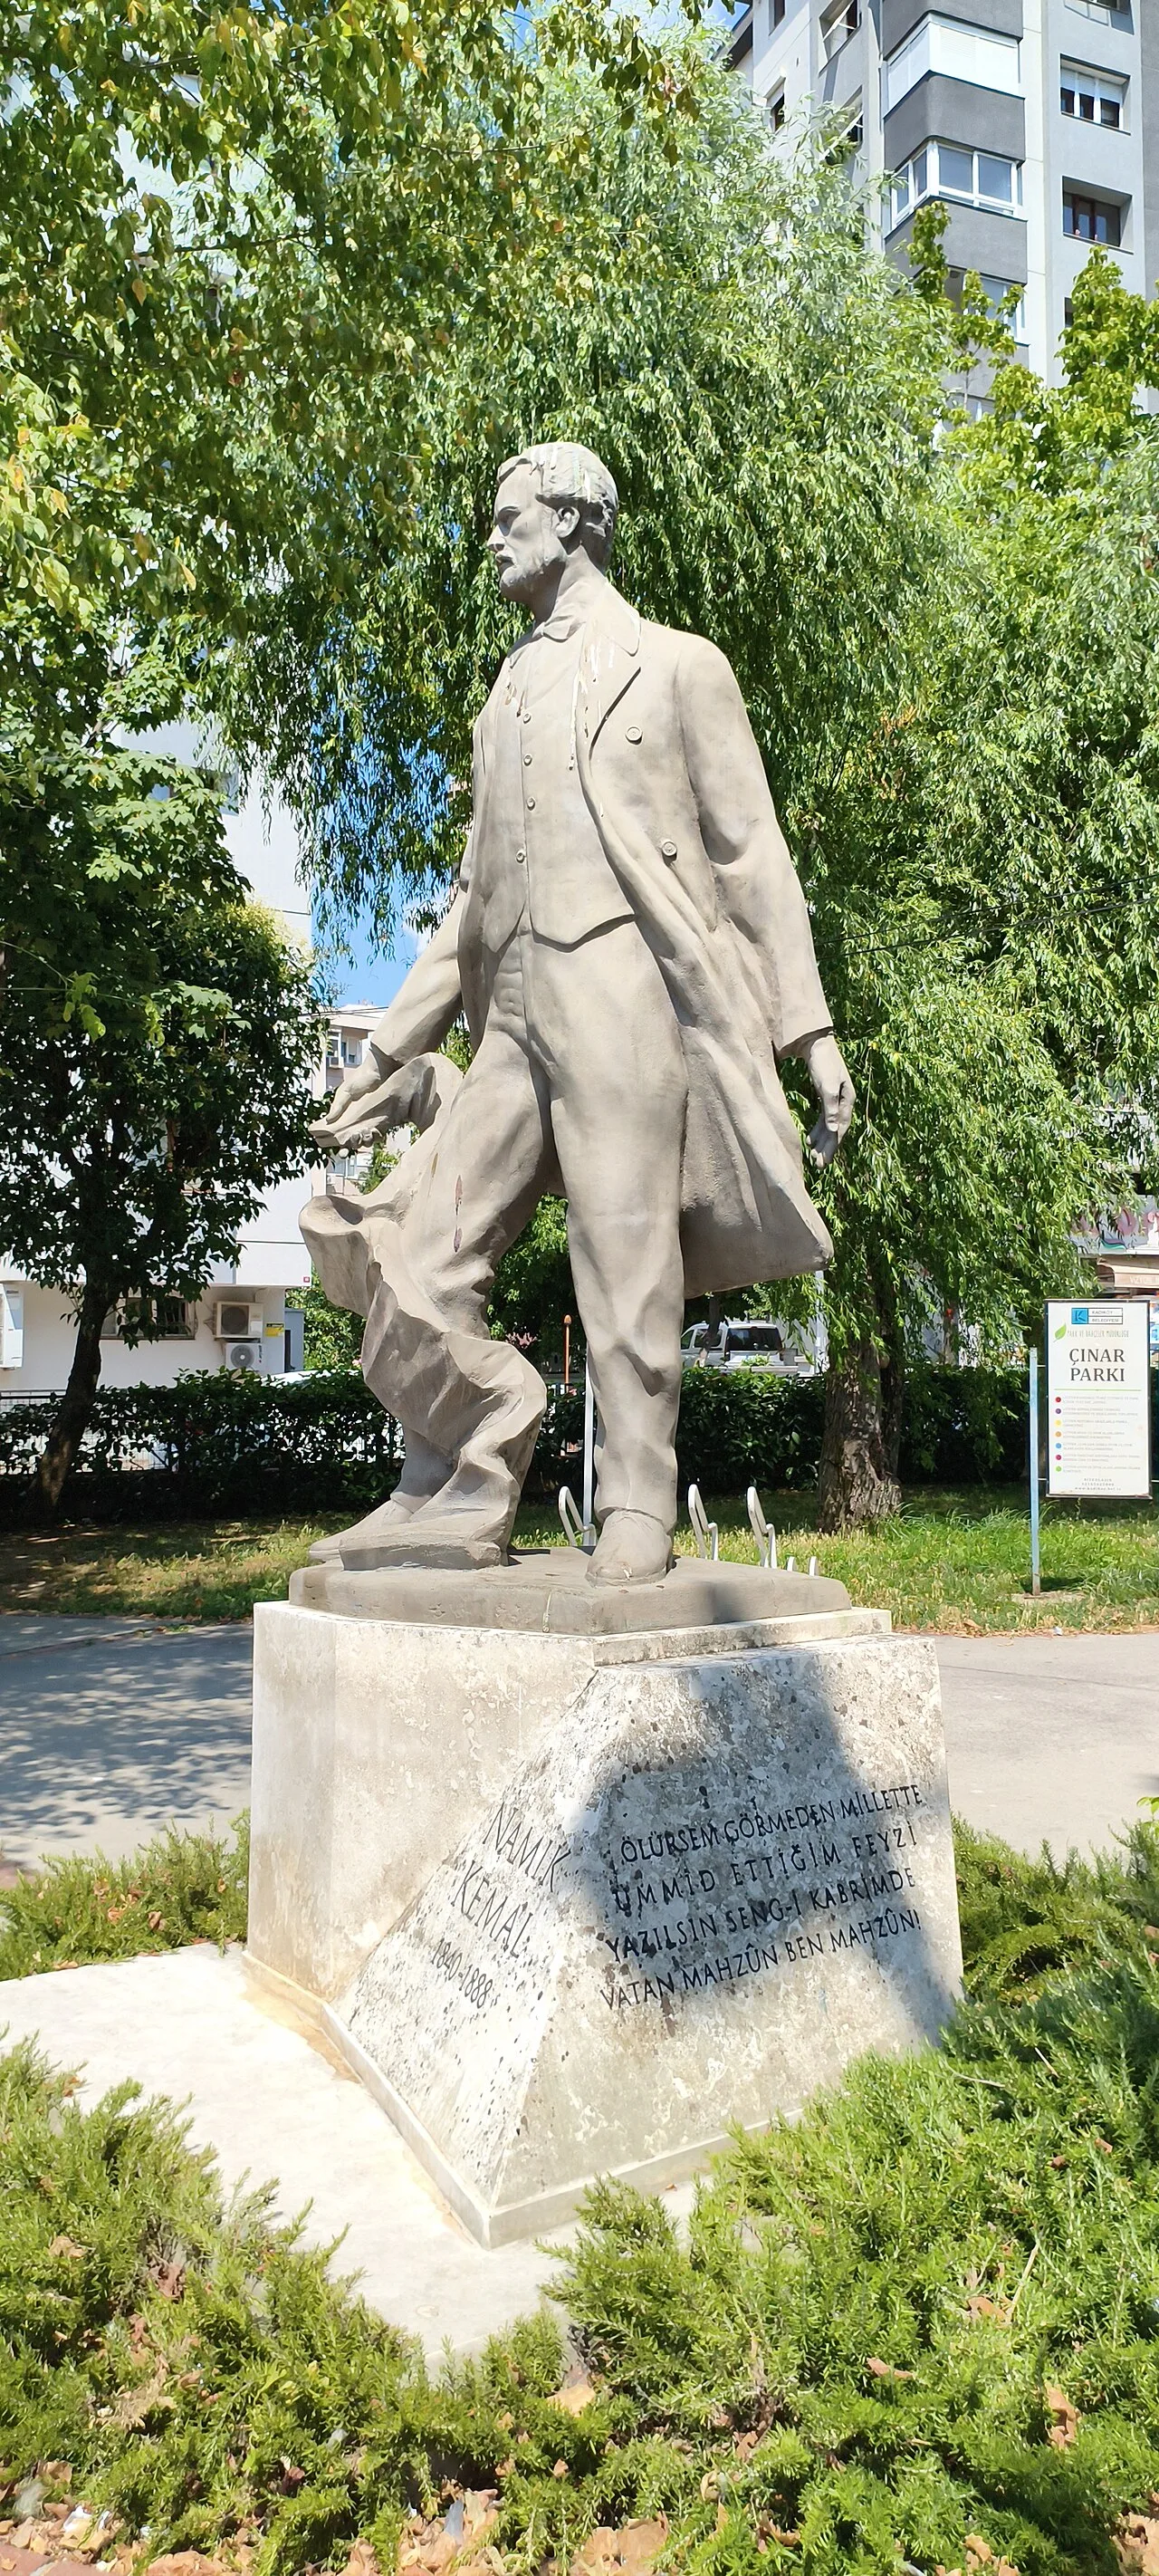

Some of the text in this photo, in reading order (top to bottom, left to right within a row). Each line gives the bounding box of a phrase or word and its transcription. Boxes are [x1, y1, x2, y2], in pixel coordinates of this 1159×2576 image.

[1069, 1349, 1125, 1366] ÇINAR
[1070, 1368, 1125, 1382] PARKI
[482, 1802, 571, 1893] NAMIK
[621, 1822, 720, 1862] ÖLÜRSEM
[724, 1801, 837, 1843] GÖRMEDEN
[731, 1841, 842, 1886] ETTİĞİM
[852, 1821, 917, 1858] FEYZİ
[451, 1860, 533, 1958] KEMAL
[606, 1914, 718, 1964] YAZILSIN
[809, 1868, 915, 1911] KABRİMDE
[431, 1937, 493, 2009] 1840-1888
[600, 1907, 922, 2010] VATAN MAHZÛN BEN MAHZÛN!
